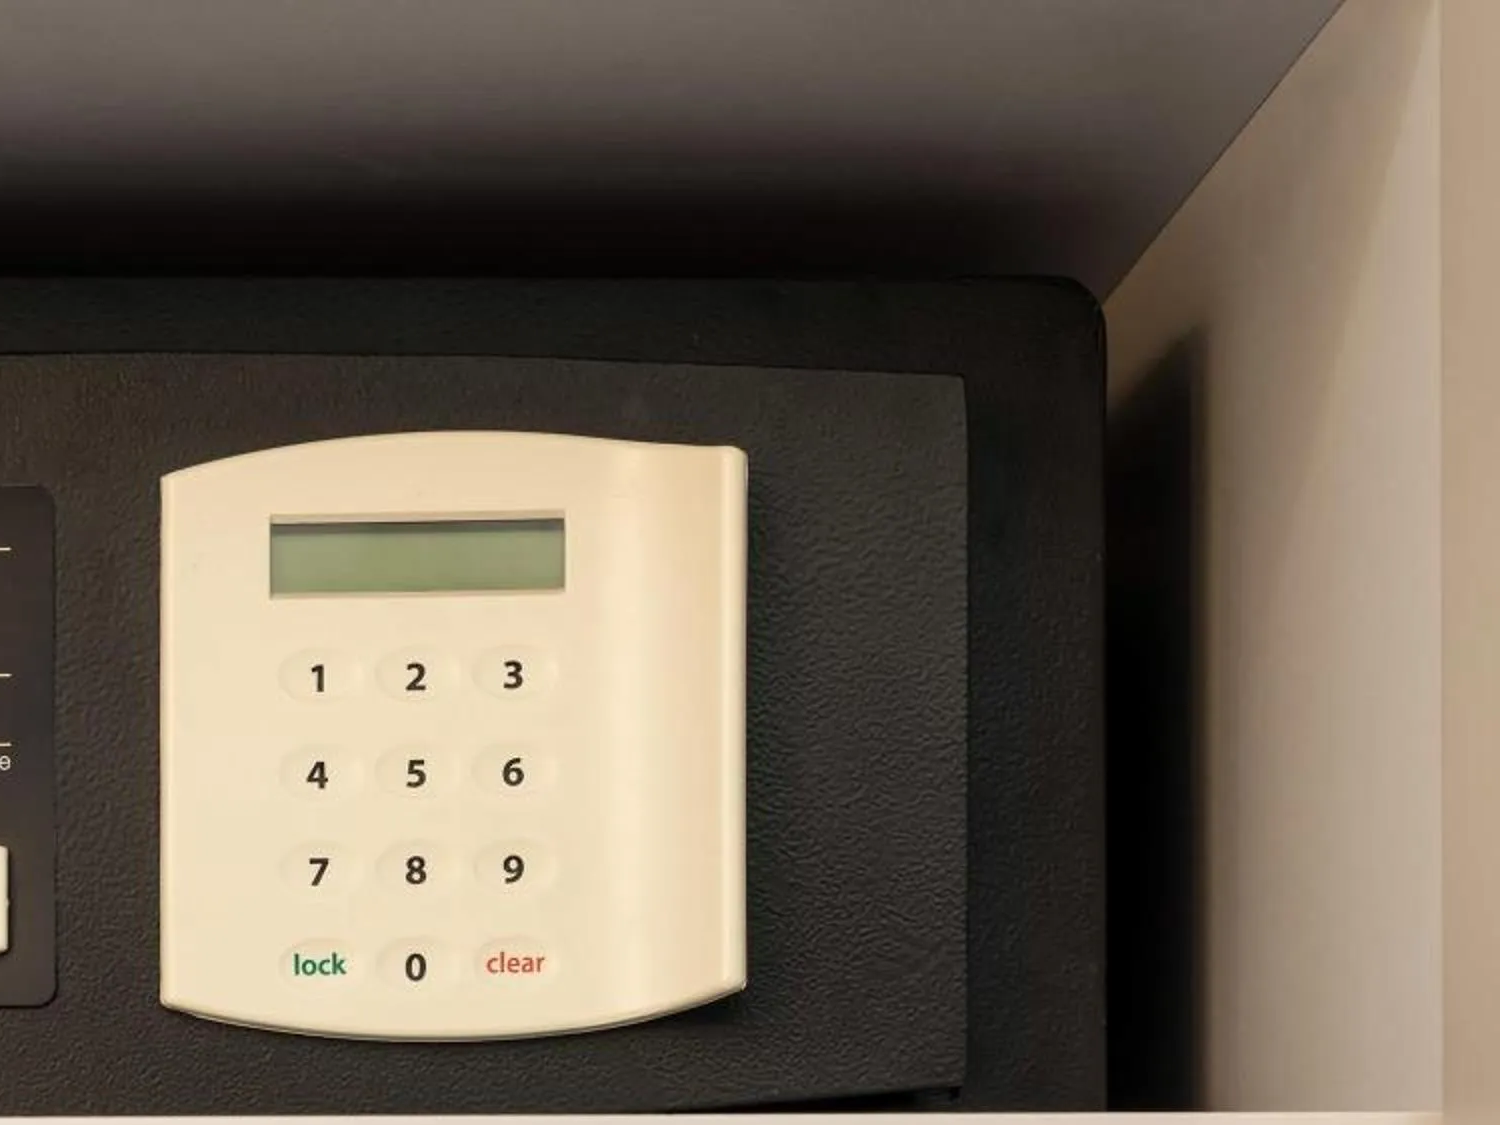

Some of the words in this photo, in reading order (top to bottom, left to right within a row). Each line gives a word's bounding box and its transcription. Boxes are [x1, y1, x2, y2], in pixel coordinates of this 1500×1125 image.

[311, 665, 325, 692] 1
[405, 663, 426, 691] 2
[503, 661, 523, 689] 3
[306, 762, 328, 789] 4
[406, 759, 426, 788] 5
[502, 758, 525, 786] 6
[308, 858, 329, 886] 7
[405, 856, 427, 884] 8
[502, 855, 525, 883] 9
[293, 953, 346, 977] lock
[405, 952, 426, 981] 0
[486, 951, 546, 975] clear
